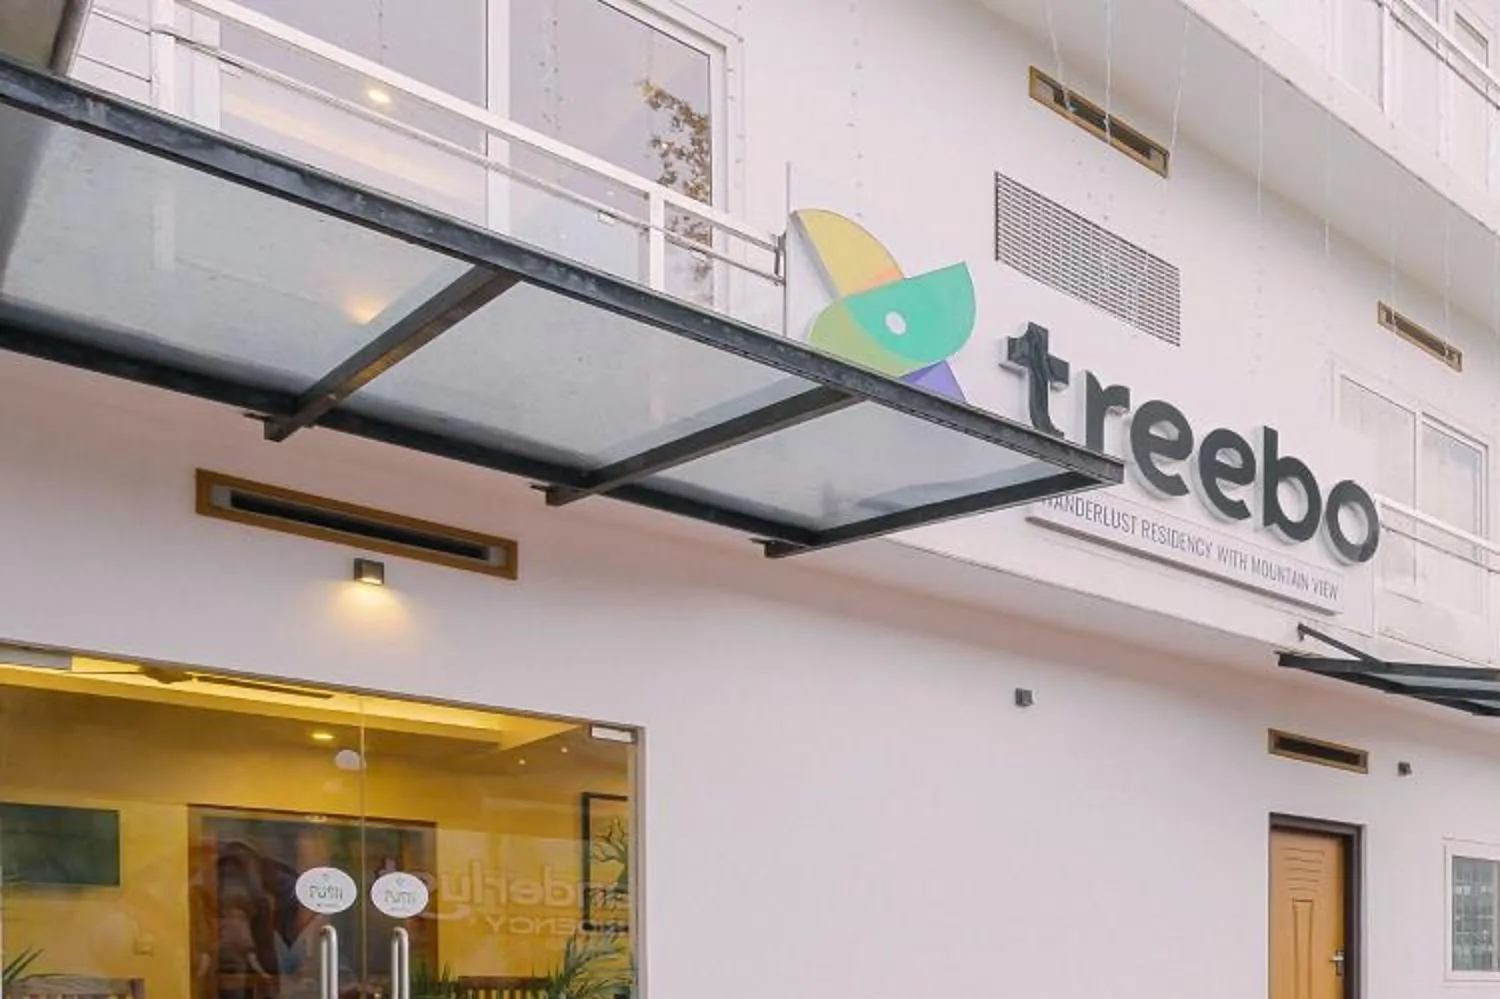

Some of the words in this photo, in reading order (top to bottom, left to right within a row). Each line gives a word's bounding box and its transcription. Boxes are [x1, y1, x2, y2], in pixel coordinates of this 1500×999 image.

[1005, 320, 1381, 564] treebo
[1141, 519, 1213, 559] RESIDENCY
[1217, 547, 1247, 571] WITH
[1251, 555, 1309, 591] MOUNTAIN
[1312, 577, 1339, 600] VIEW
